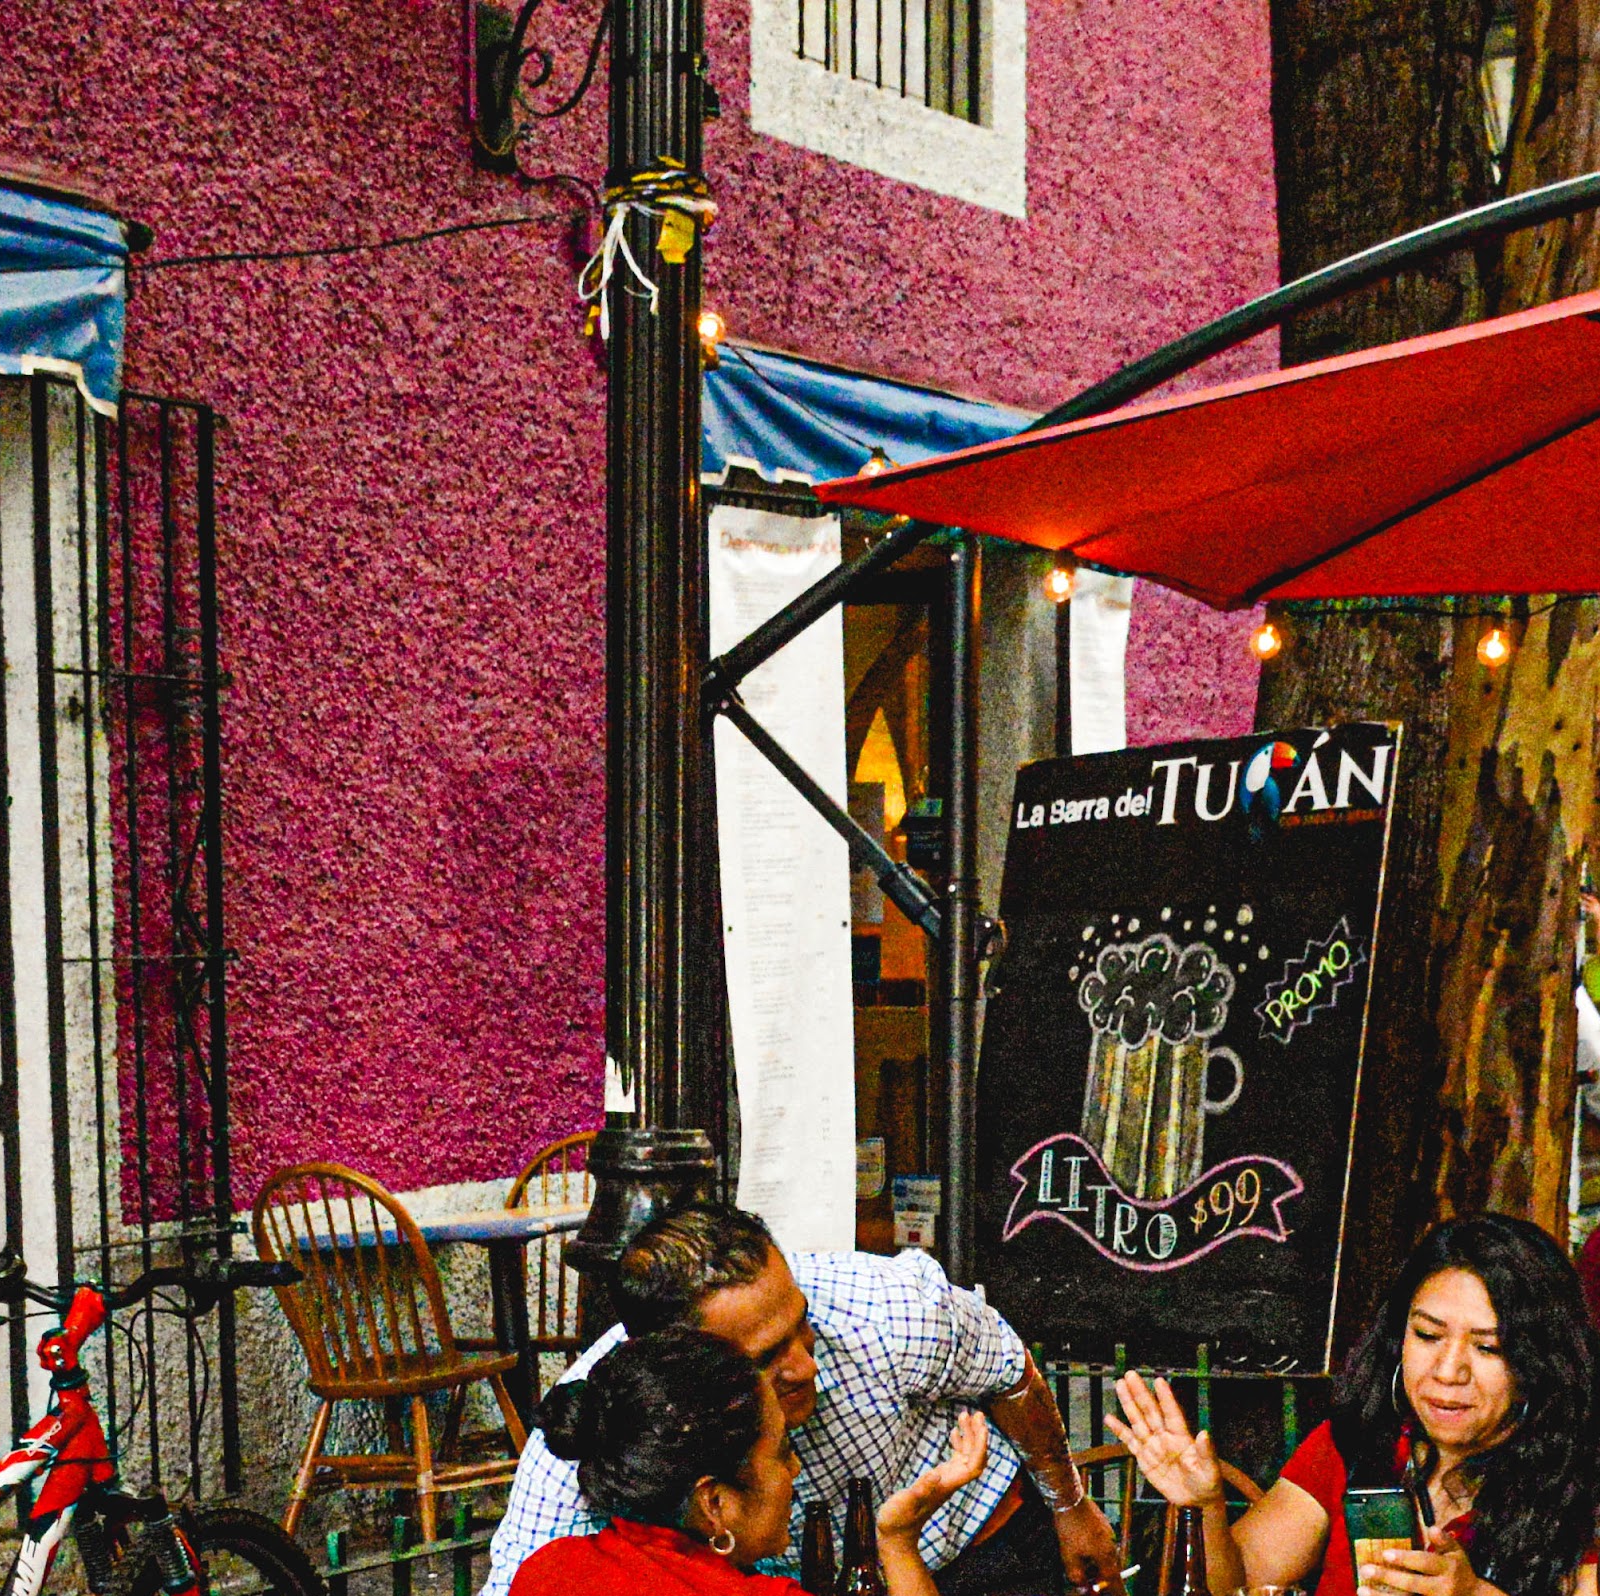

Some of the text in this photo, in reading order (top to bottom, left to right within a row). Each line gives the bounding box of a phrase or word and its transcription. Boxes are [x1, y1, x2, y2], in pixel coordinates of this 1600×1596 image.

[1016, 802, 1045, 829] La
[1049, 797, 1109, 825] Barra
[1114, 785, 1154, 817] del
[1151, 731, 1393, 826] TUÁN
[1264, 940, 1351, 1029] PROMO
[1038, 1149, 1178, 1260] LITRO
[1189, 1168, 1261, 1238] $99
